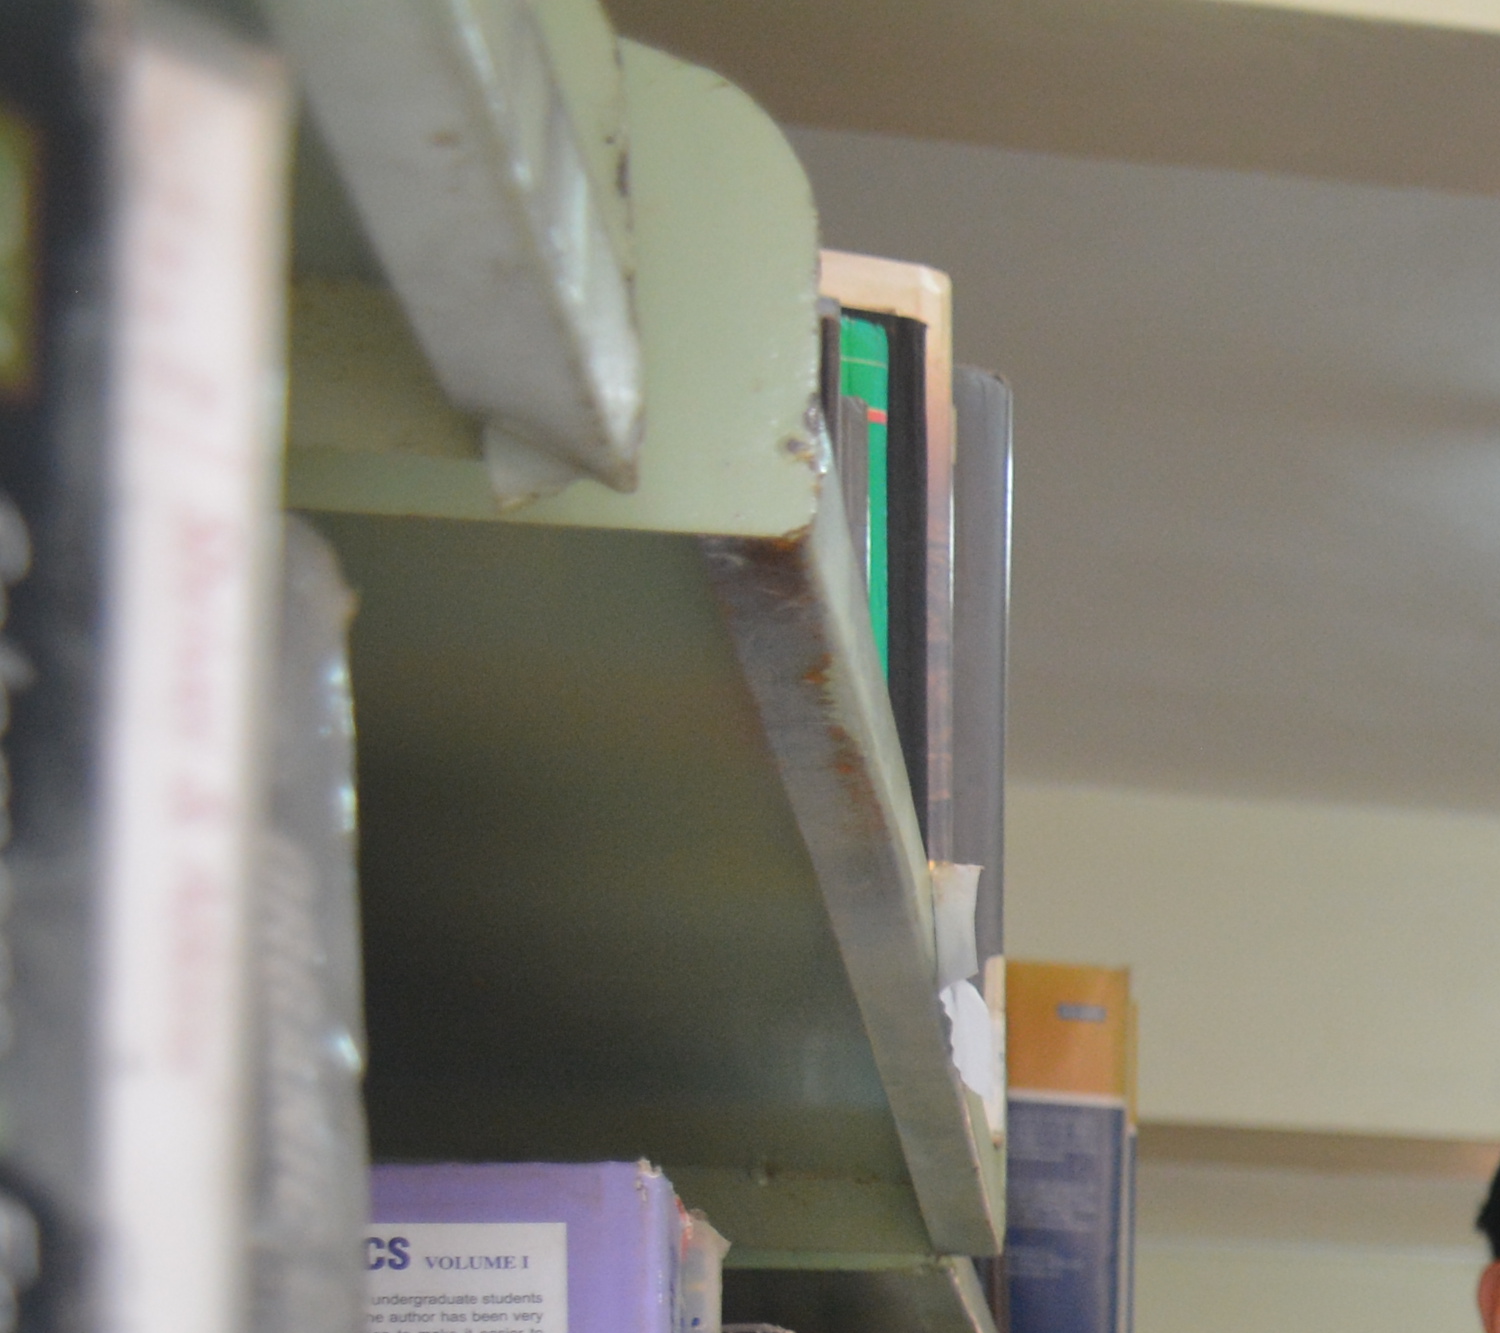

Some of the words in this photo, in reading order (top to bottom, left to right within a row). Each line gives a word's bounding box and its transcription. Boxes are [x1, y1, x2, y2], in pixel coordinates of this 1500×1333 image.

[425, 1256, 516, 1270] VOLUME
[522, 1256, 529, 1269] I
[372, 1294, 478, 1307] undergraduate
[482, 1293, 543, 1304] students
